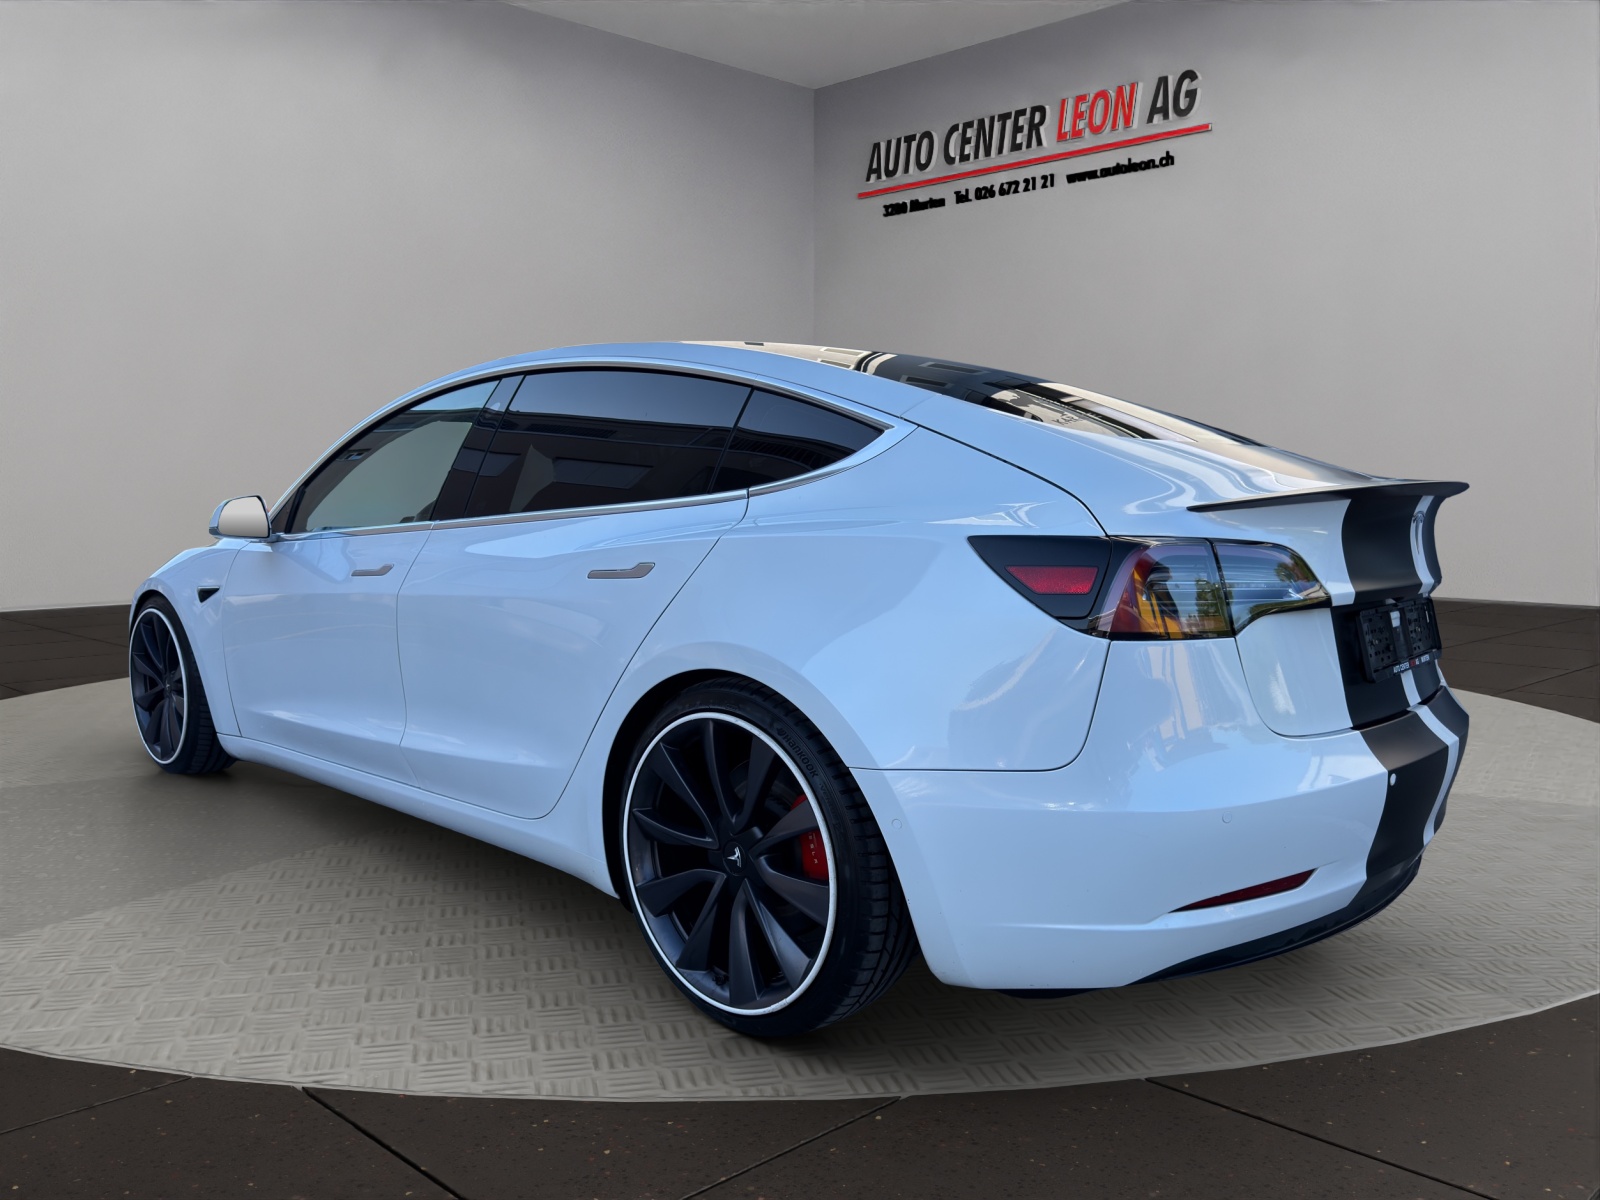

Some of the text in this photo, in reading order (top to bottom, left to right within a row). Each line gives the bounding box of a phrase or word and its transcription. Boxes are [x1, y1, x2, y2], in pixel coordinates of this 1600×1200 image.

[865, 69, 1200, 182] AUTO CENTER LEON AG
[975, 185, 996, 200] 026
[998, 180, 1020, 196] 672
[1023, 177, 1036, 192] 21
[1041, 174, 1054, 189] 21
[1066, 151, 1174, 183] www.autoleon.ch
